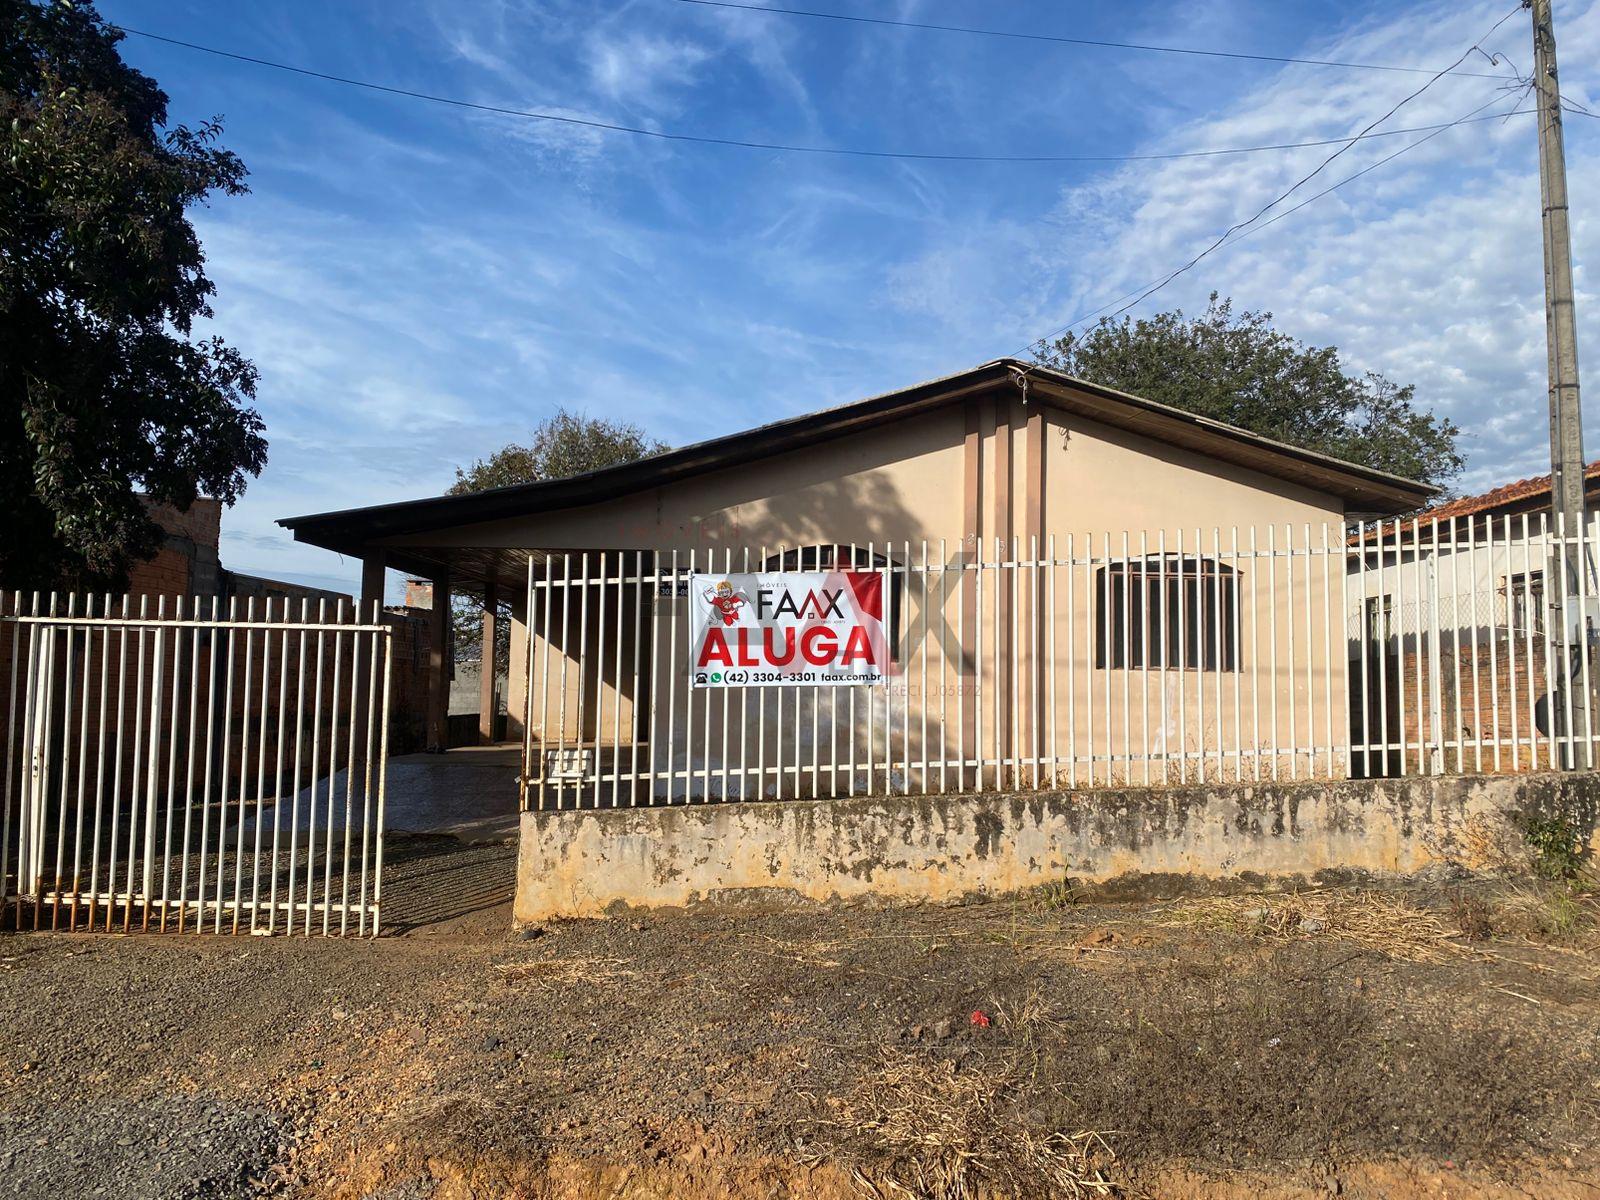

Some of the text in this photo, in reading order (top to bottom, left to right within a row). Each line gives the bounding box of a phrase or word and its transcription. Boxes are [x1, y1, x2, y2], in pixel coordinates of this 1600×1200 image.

[757, 588, 844, 620] FAAX
[697, 626, 876, 667] ALUGA
[724, 671, 881, 684] (42) 3304-3301 faax.com.br
